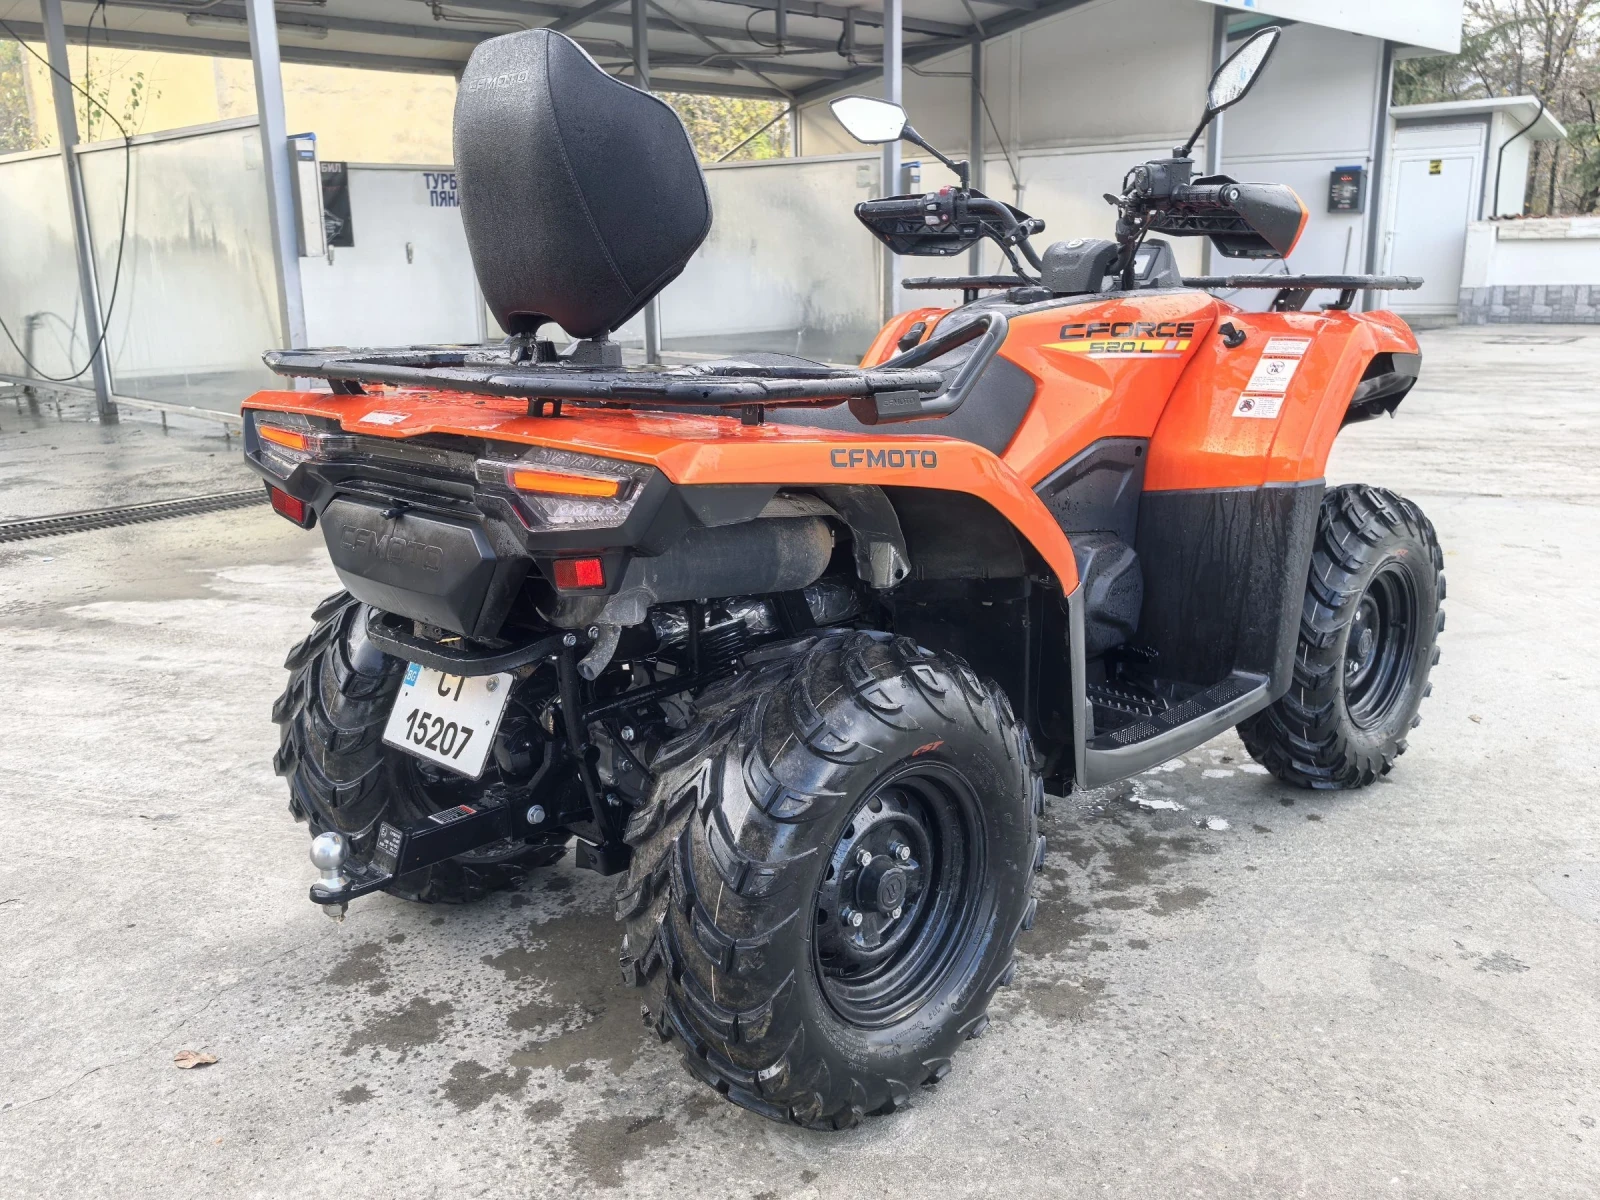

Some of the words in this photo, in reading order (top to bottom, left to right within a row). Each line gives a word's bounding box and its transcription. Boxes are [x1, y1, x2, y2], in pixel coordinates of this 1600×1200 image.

[468, 70, 529, 92] CFMOTO
[1059, 322, 1195, 340] CFORCE
[1088, 341, 1136, 354] 520
[1140, 342, 1153, 354] L
[830, 448, 938, 469] CFMOTO
[340, 524, 444, 573] CFMOTO
[406, 669, 417, 682] BG
[405, 707, 475, 760] 15207
